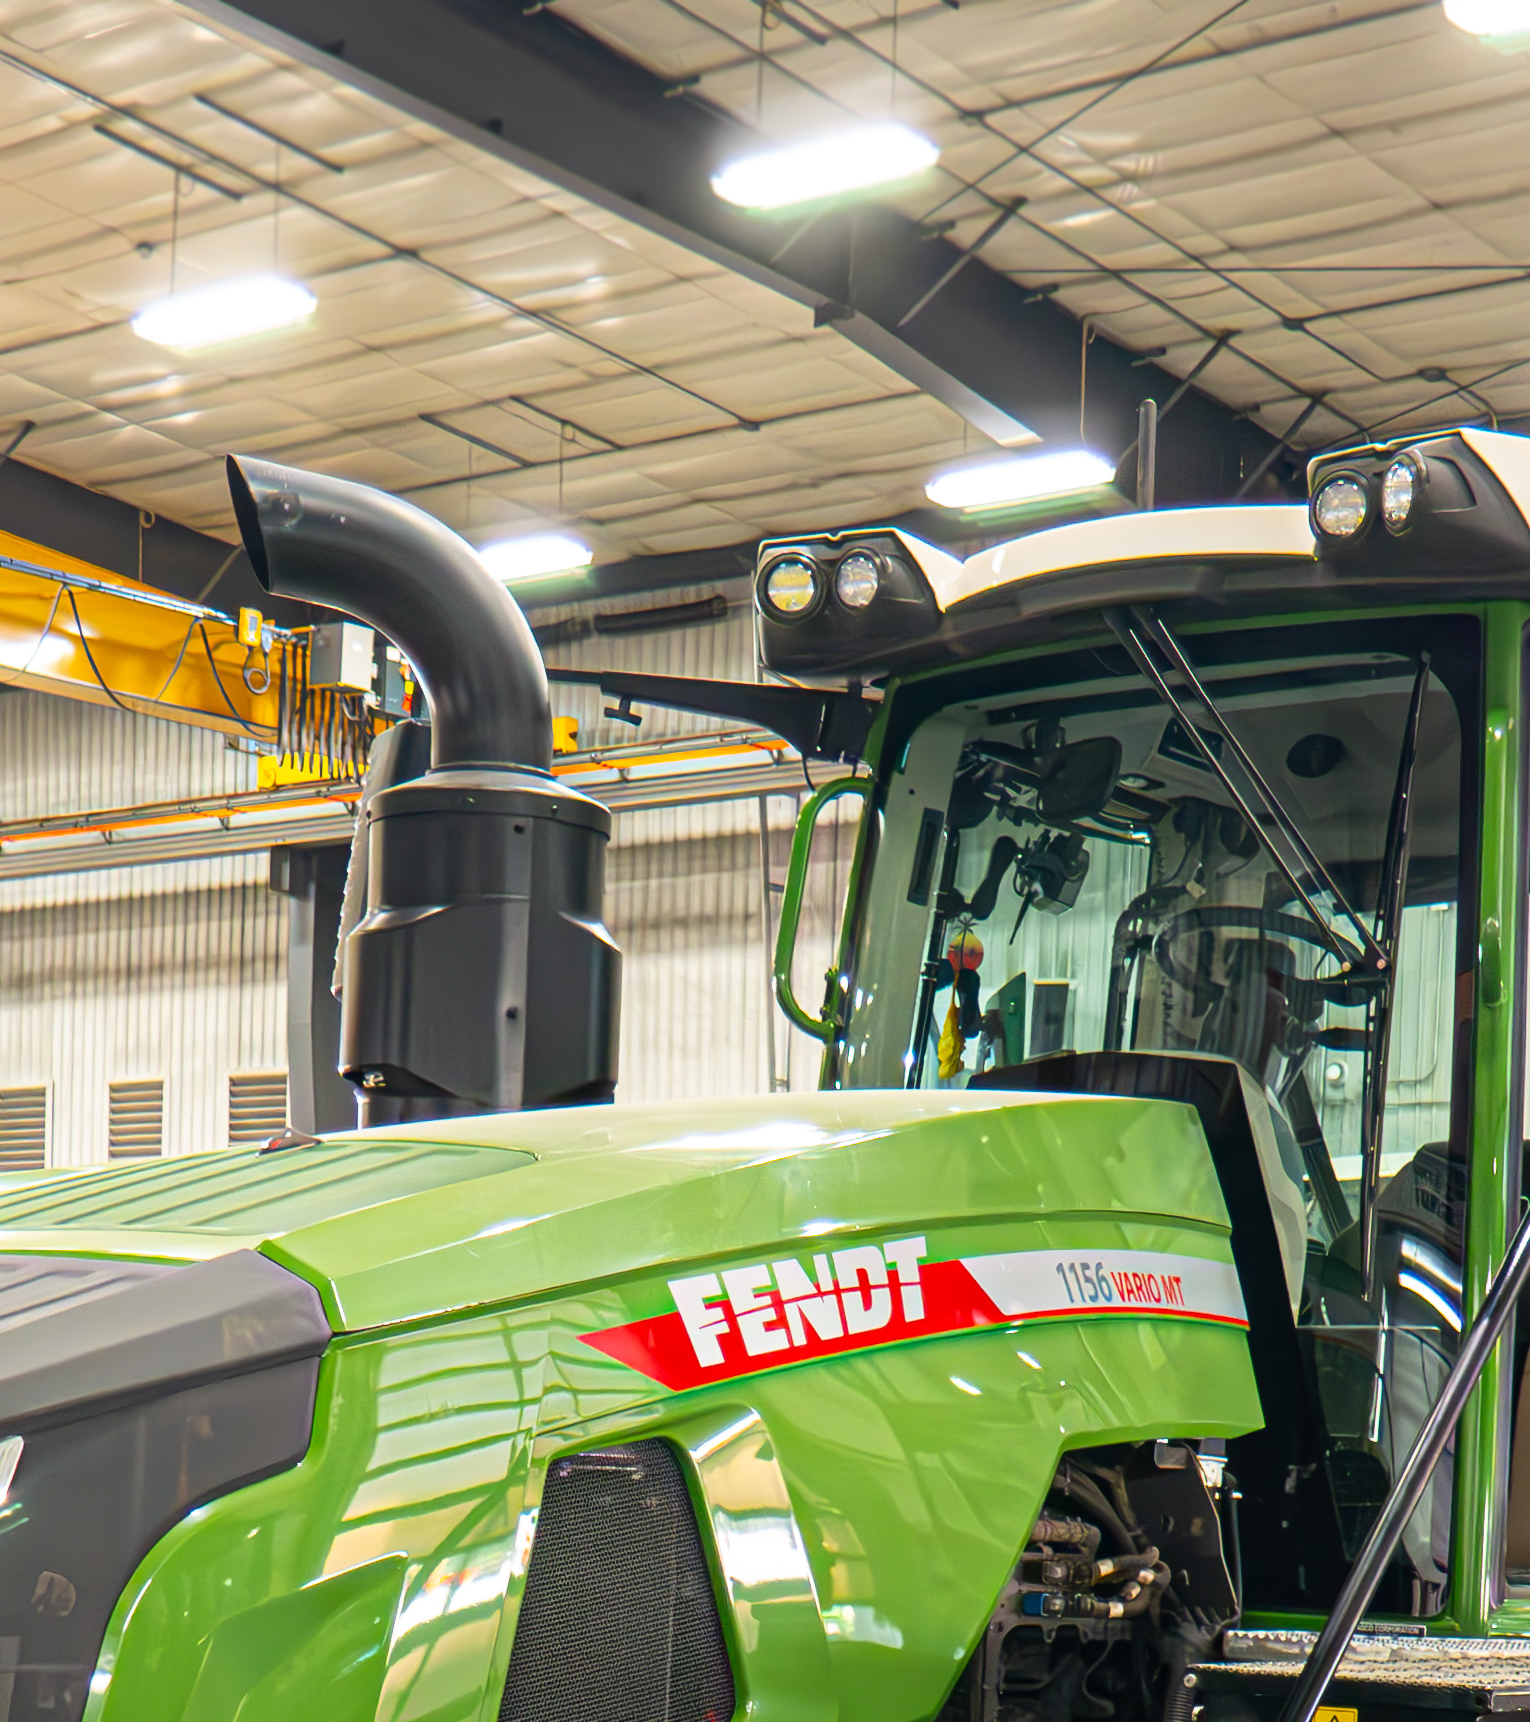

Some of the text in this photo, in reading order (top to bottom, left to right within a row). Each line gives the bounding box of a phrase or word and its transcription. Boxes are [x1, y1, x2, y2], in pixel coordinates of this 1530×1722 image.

[666, 1235, 928, 1369] FENDT
[1055, 1261, 1186, 1307] 1156 VARIO MT
